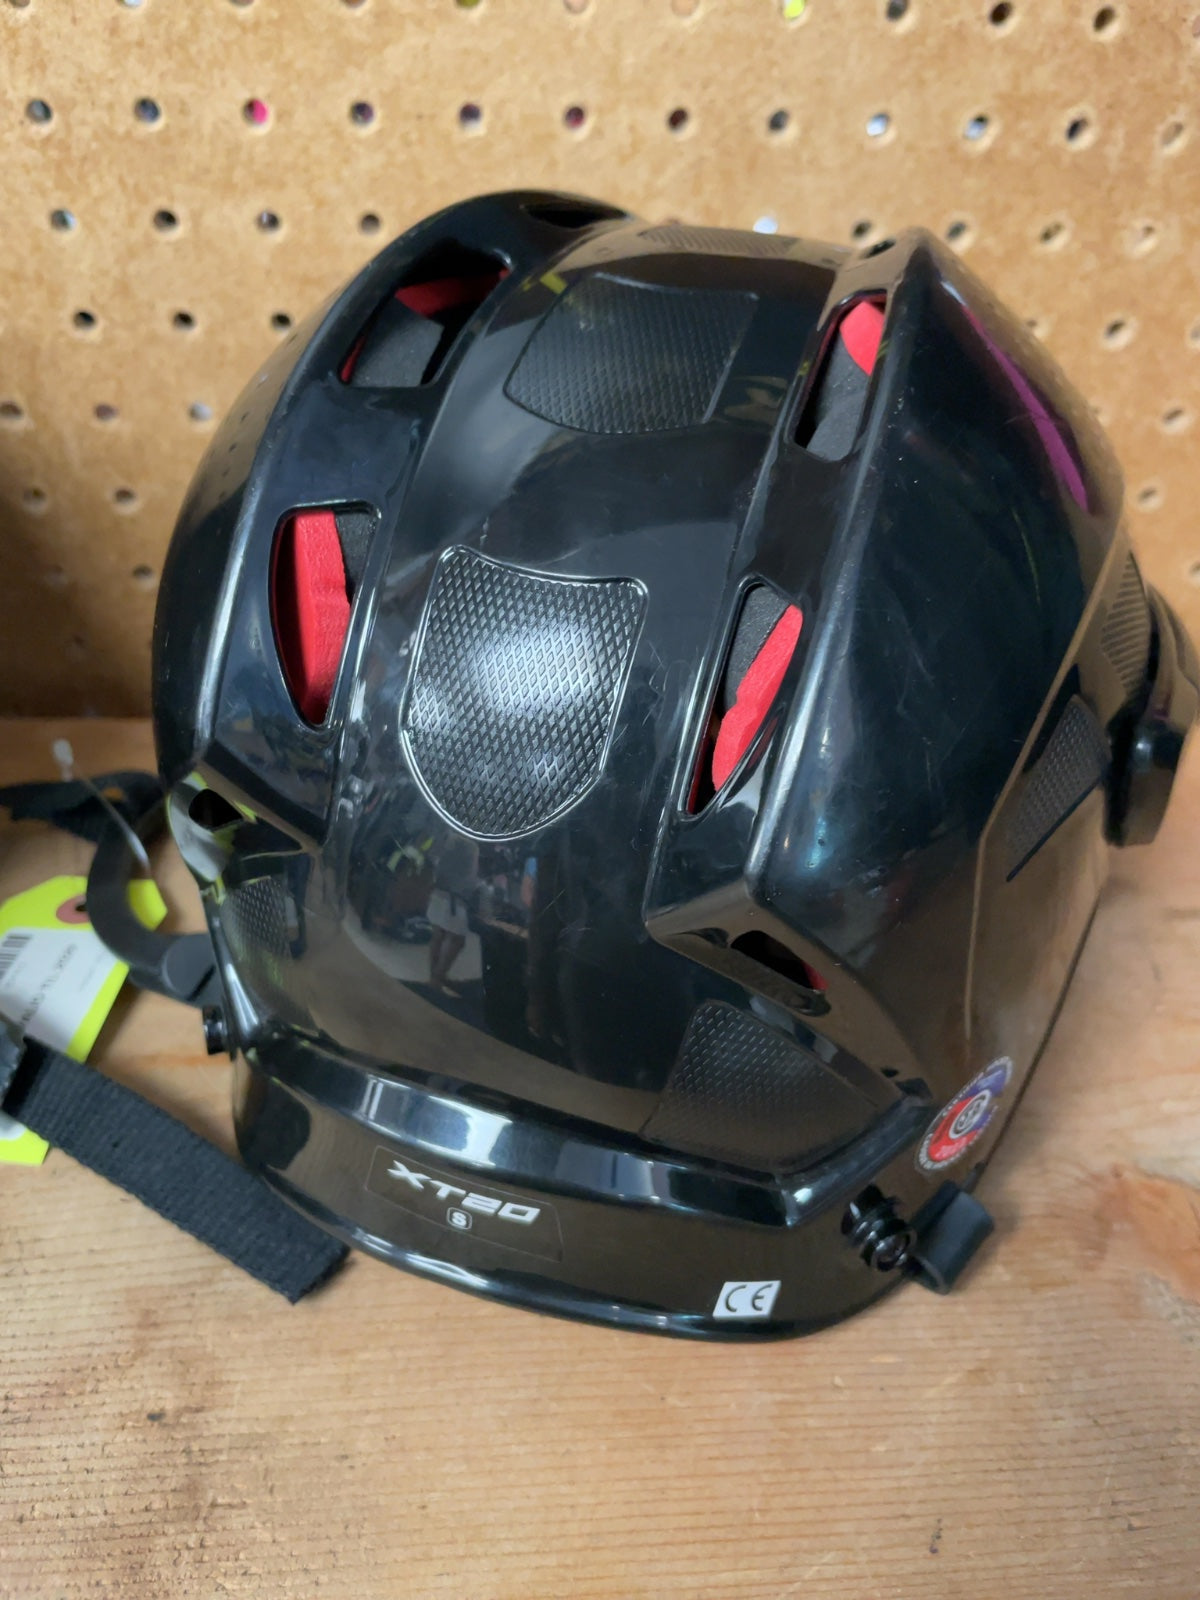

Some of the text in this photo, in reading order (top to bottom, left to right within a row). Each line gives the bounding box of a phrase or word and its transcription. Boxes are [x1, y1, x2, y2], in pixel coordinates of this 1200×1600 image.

[387, 1160, 541, 1225] XT20
[451, 1211, 468, 1227] S
[725, 1284, 773, 1312] CE
